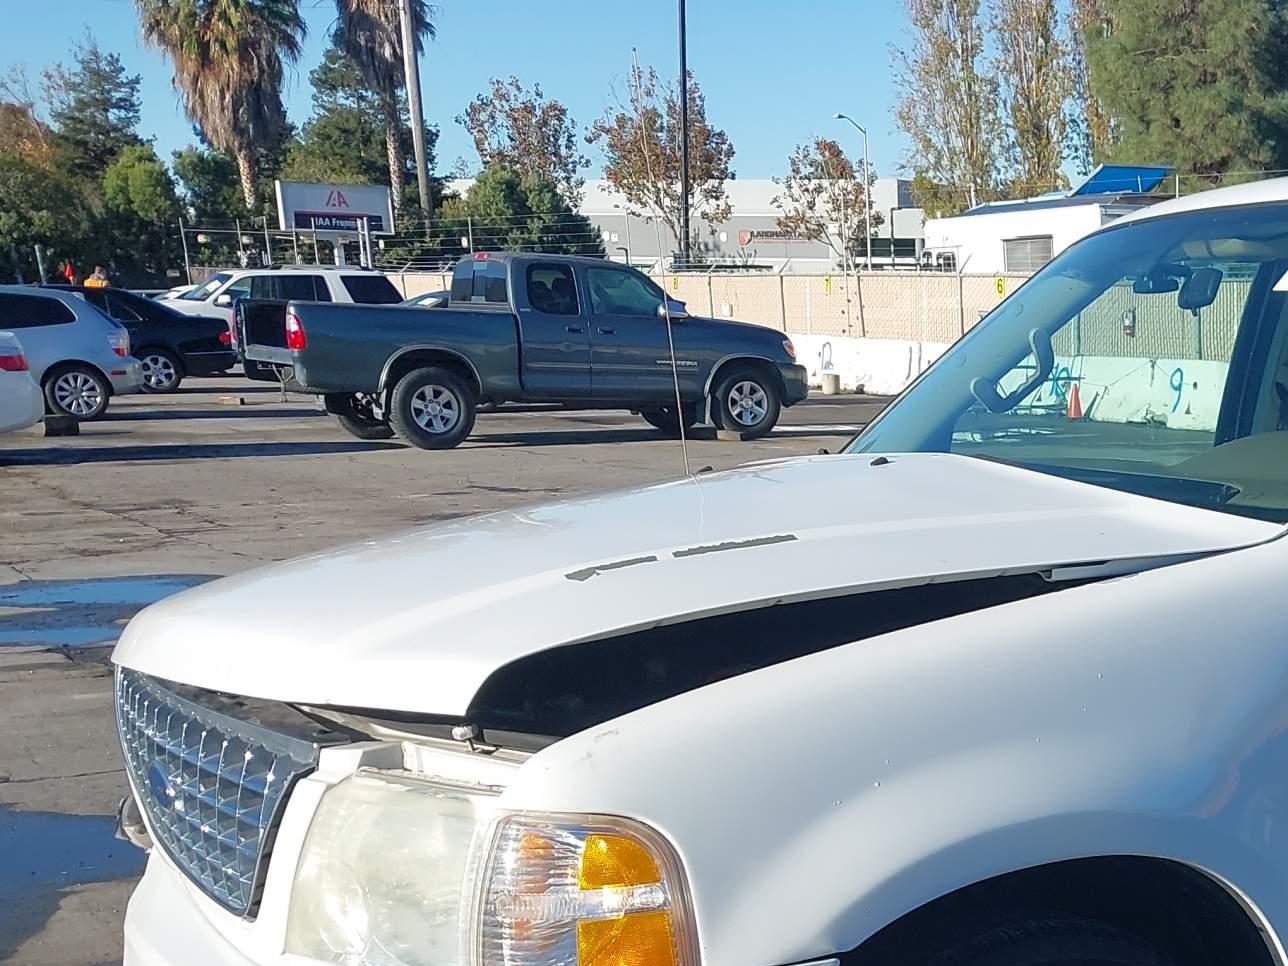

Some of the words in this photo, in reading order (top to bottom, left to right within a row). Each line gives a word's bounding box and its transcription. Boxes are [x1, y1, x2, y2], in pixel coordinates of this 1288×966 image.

[315, 216, 331, 227] IAA
[997, 278, 1003, 294] 6
[1169, 367, 1183, 413] 9
